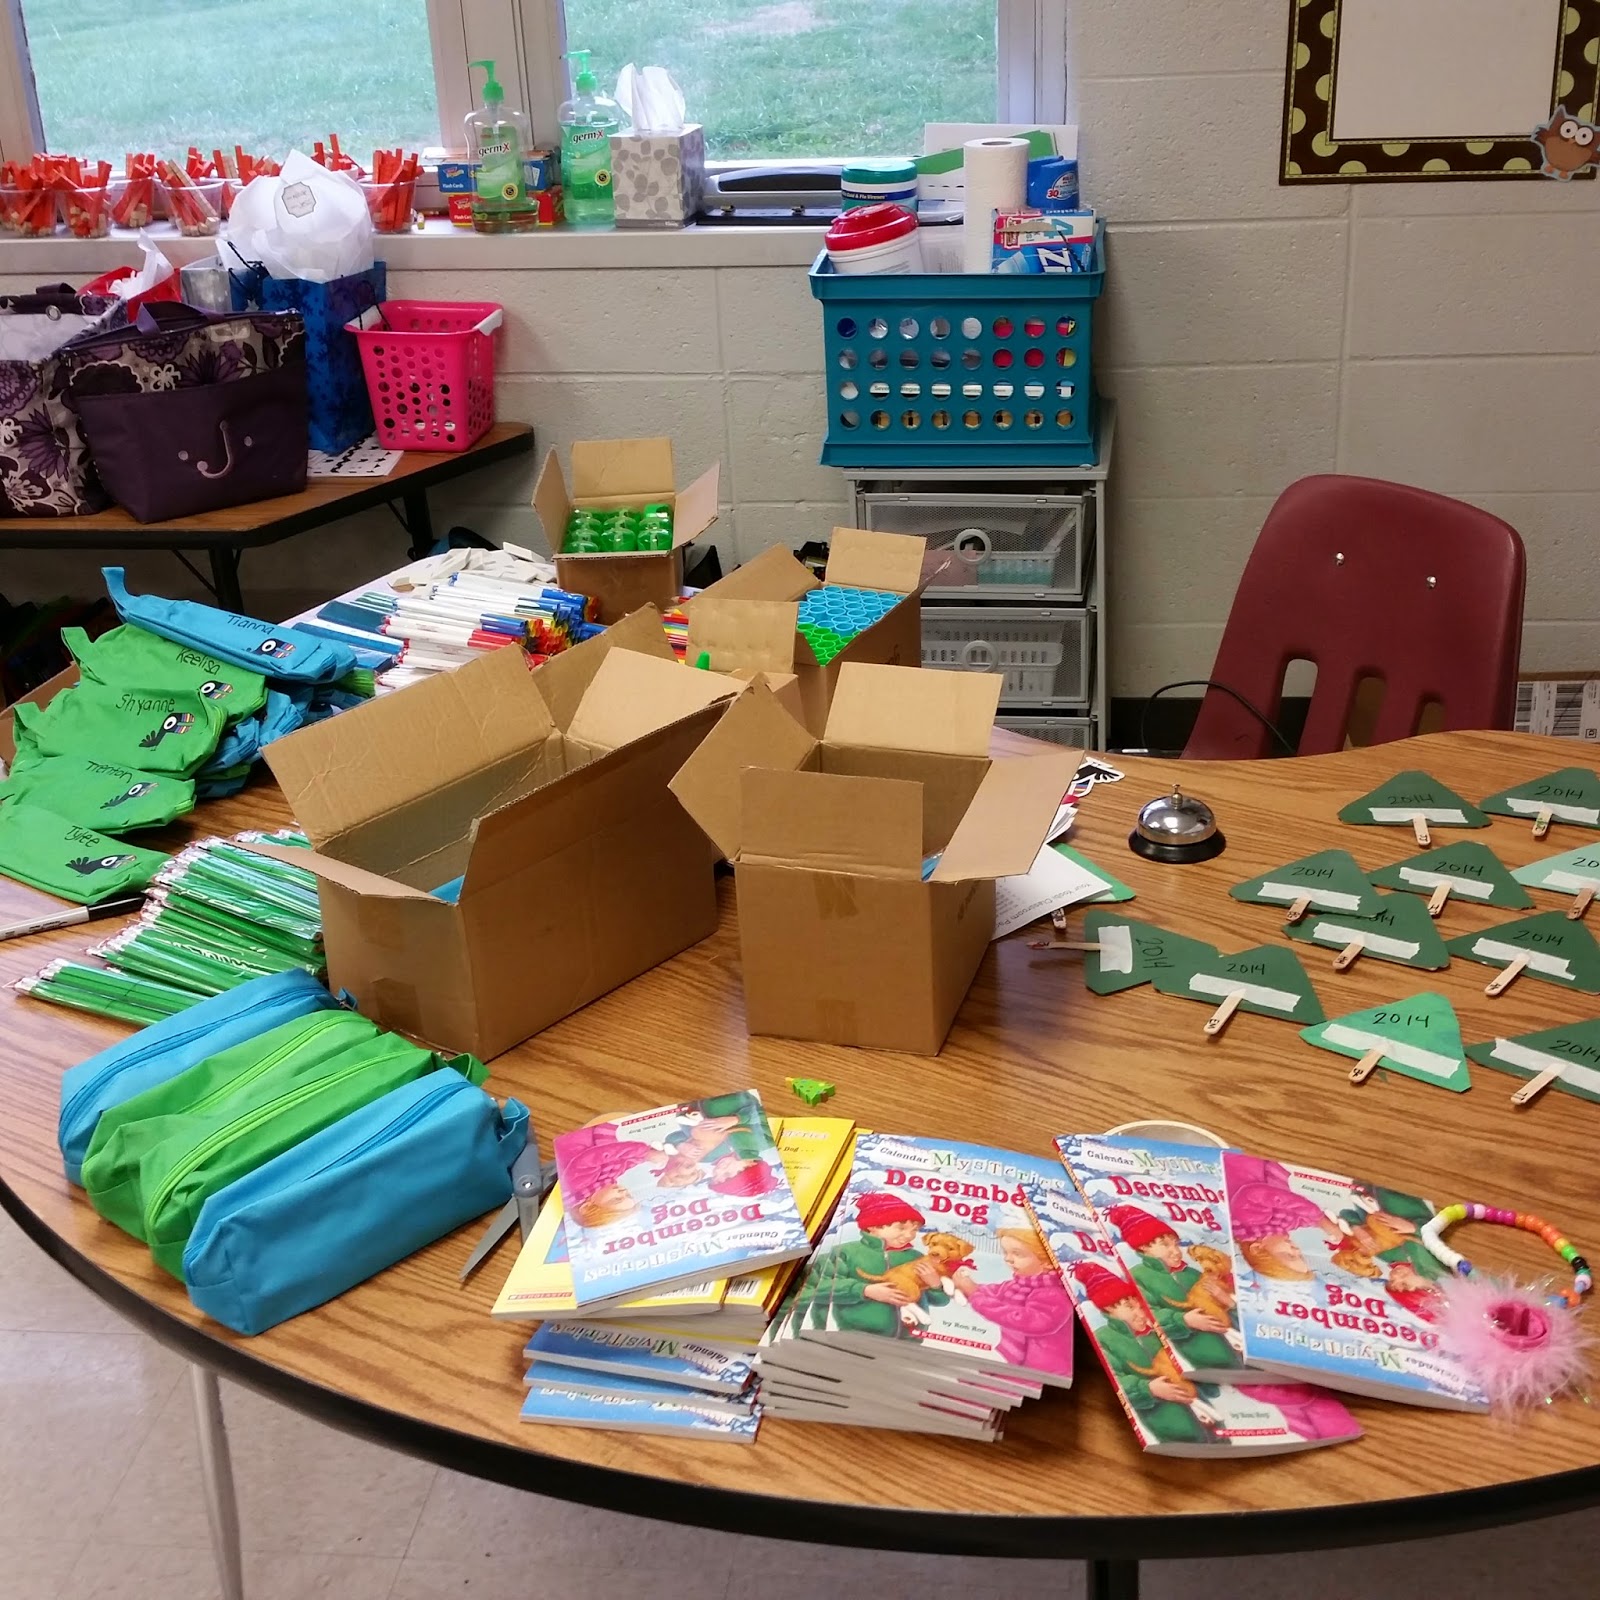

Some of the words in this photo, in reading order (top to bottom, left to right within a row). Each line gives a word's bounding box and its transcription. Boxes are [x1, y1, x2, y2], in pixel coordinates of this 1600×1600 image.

[1047, 189, 1060, 198] 30
[227, 613, 276, 635] Tianna
[175, 648, 221, 676] Keelisa
[115, 693, 176, 716] Shyanne
[86, 760, 133, 784] Trenton
[1388, 793, 1434, 805] 2014
[1535, 785, 1584, 799] 2014
[64, 825, 100, 848] Tylee
[1291, 866, 1334, 879] 2014
[1434, 861, 1484, 876] 2014
[1572, 856, 1600, 868] 20
[1512, 930, 1564, 946] 2014
[1135, 936, 1175, 969] 2014
[1227, 962, 1265, 976] 2014
[1373, 1012, 1430, 1028] 2014
[879, 1147, 929, 1164] Calendar
[1087, 1149, 1135, 1166] Calendar
[883, 1168, 1028, 1208] Decembe
[1108, 1174, 1225, 1204] Decemb
[650, 1197, 712, 1225] Dog
[930, 1194, 990, 1225] Dog
[1052, 1201, 1093, 1222] Calenda
[1162, 1201, 1223, 1231] Dog
[602, 1203, 765, 1255] December
[726, 1230, 779, 1242] Calendar
[1325, 1283, 1389, 1319] Dog
[942, 1320, 952, 1328] by
[954, 1322, 970, 1331] Ron
[972, 1325, 987, 1334] Roy
[1275, 1299, 1441, 1350] December
[921, 1332, 991, 1351] SCHOLASTIC
[681, 1343, 729, 1364] Calendar
